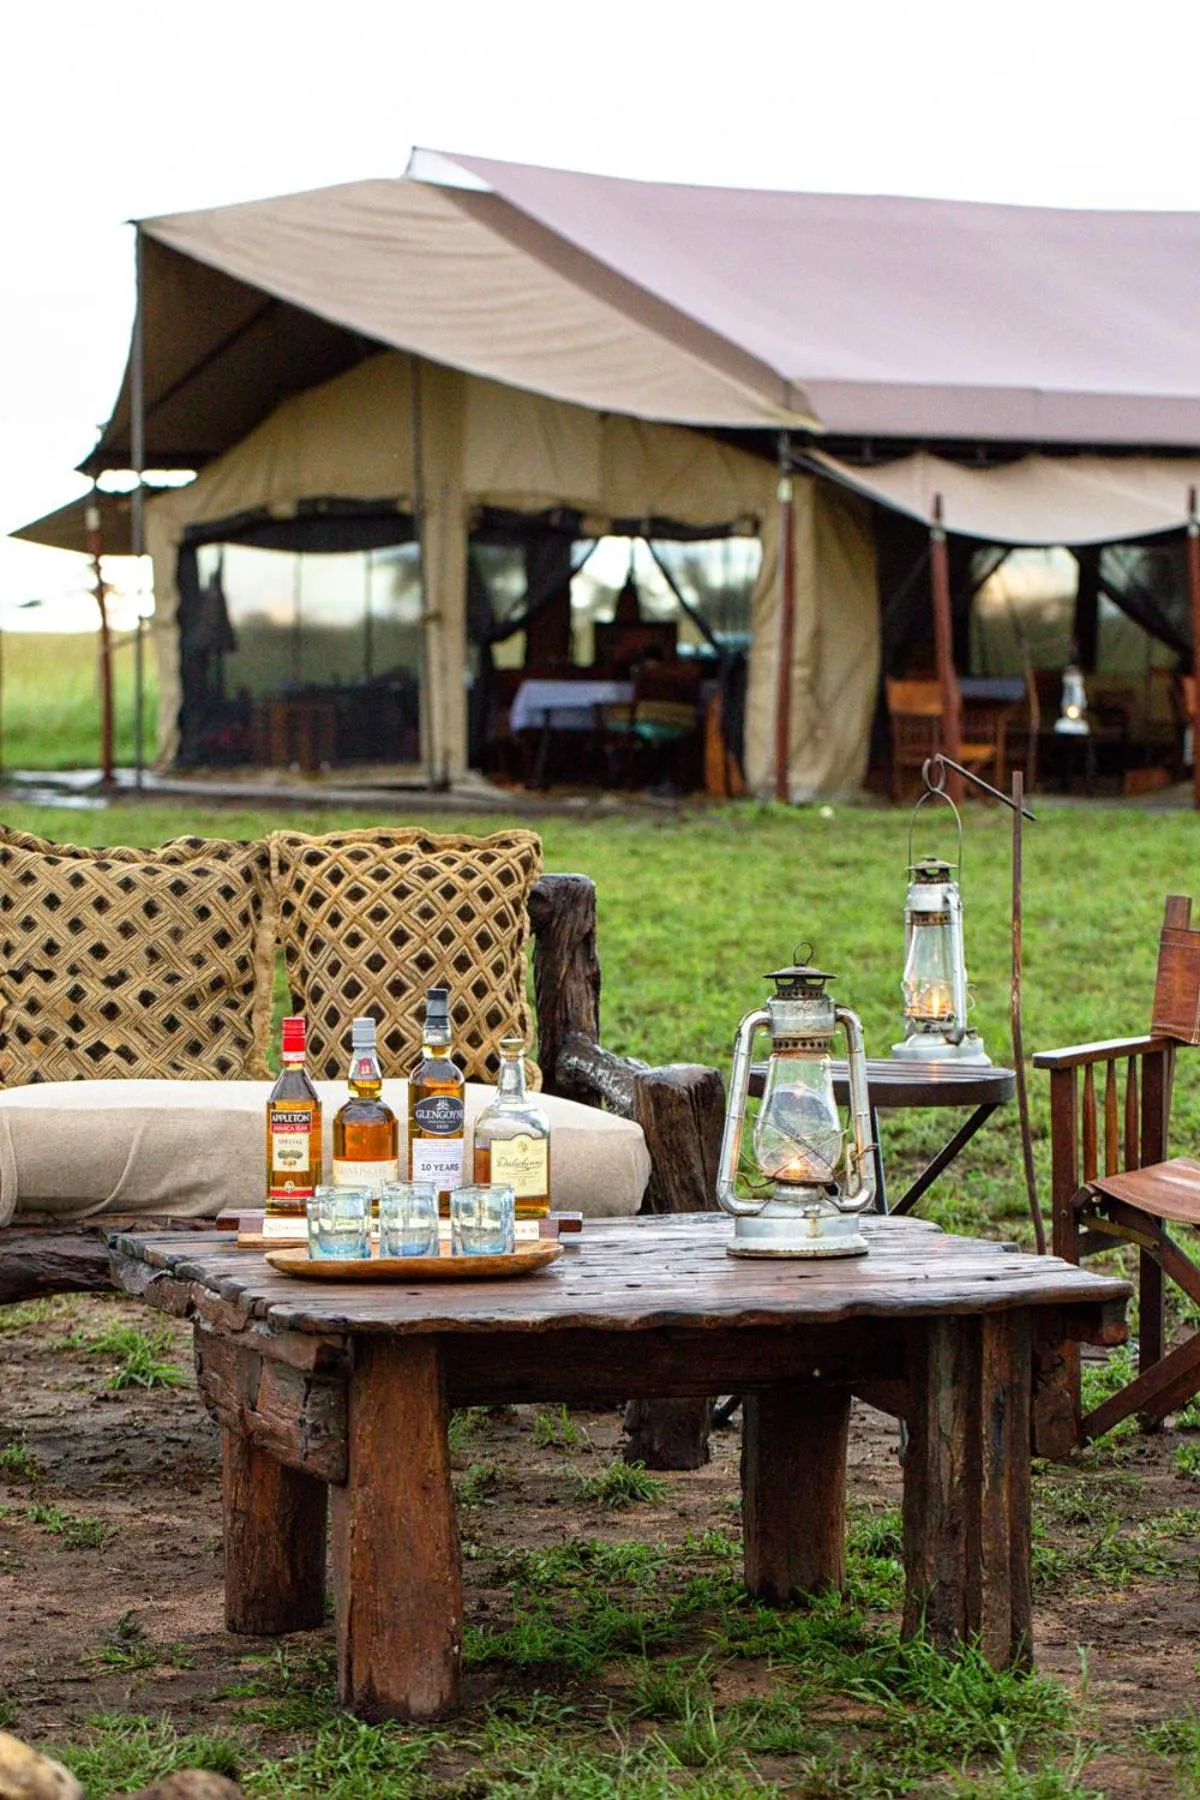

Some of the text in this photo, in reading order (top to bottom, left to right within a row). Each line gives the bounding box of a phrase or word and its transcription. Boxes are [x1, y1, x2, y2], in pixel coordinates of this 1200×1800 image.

[272, 1113, 309, 1123] APPLETON
[415, 1110, 464, 1119] GLENGOYN
[421, 1163, 459, 1171] 10 YEARS
